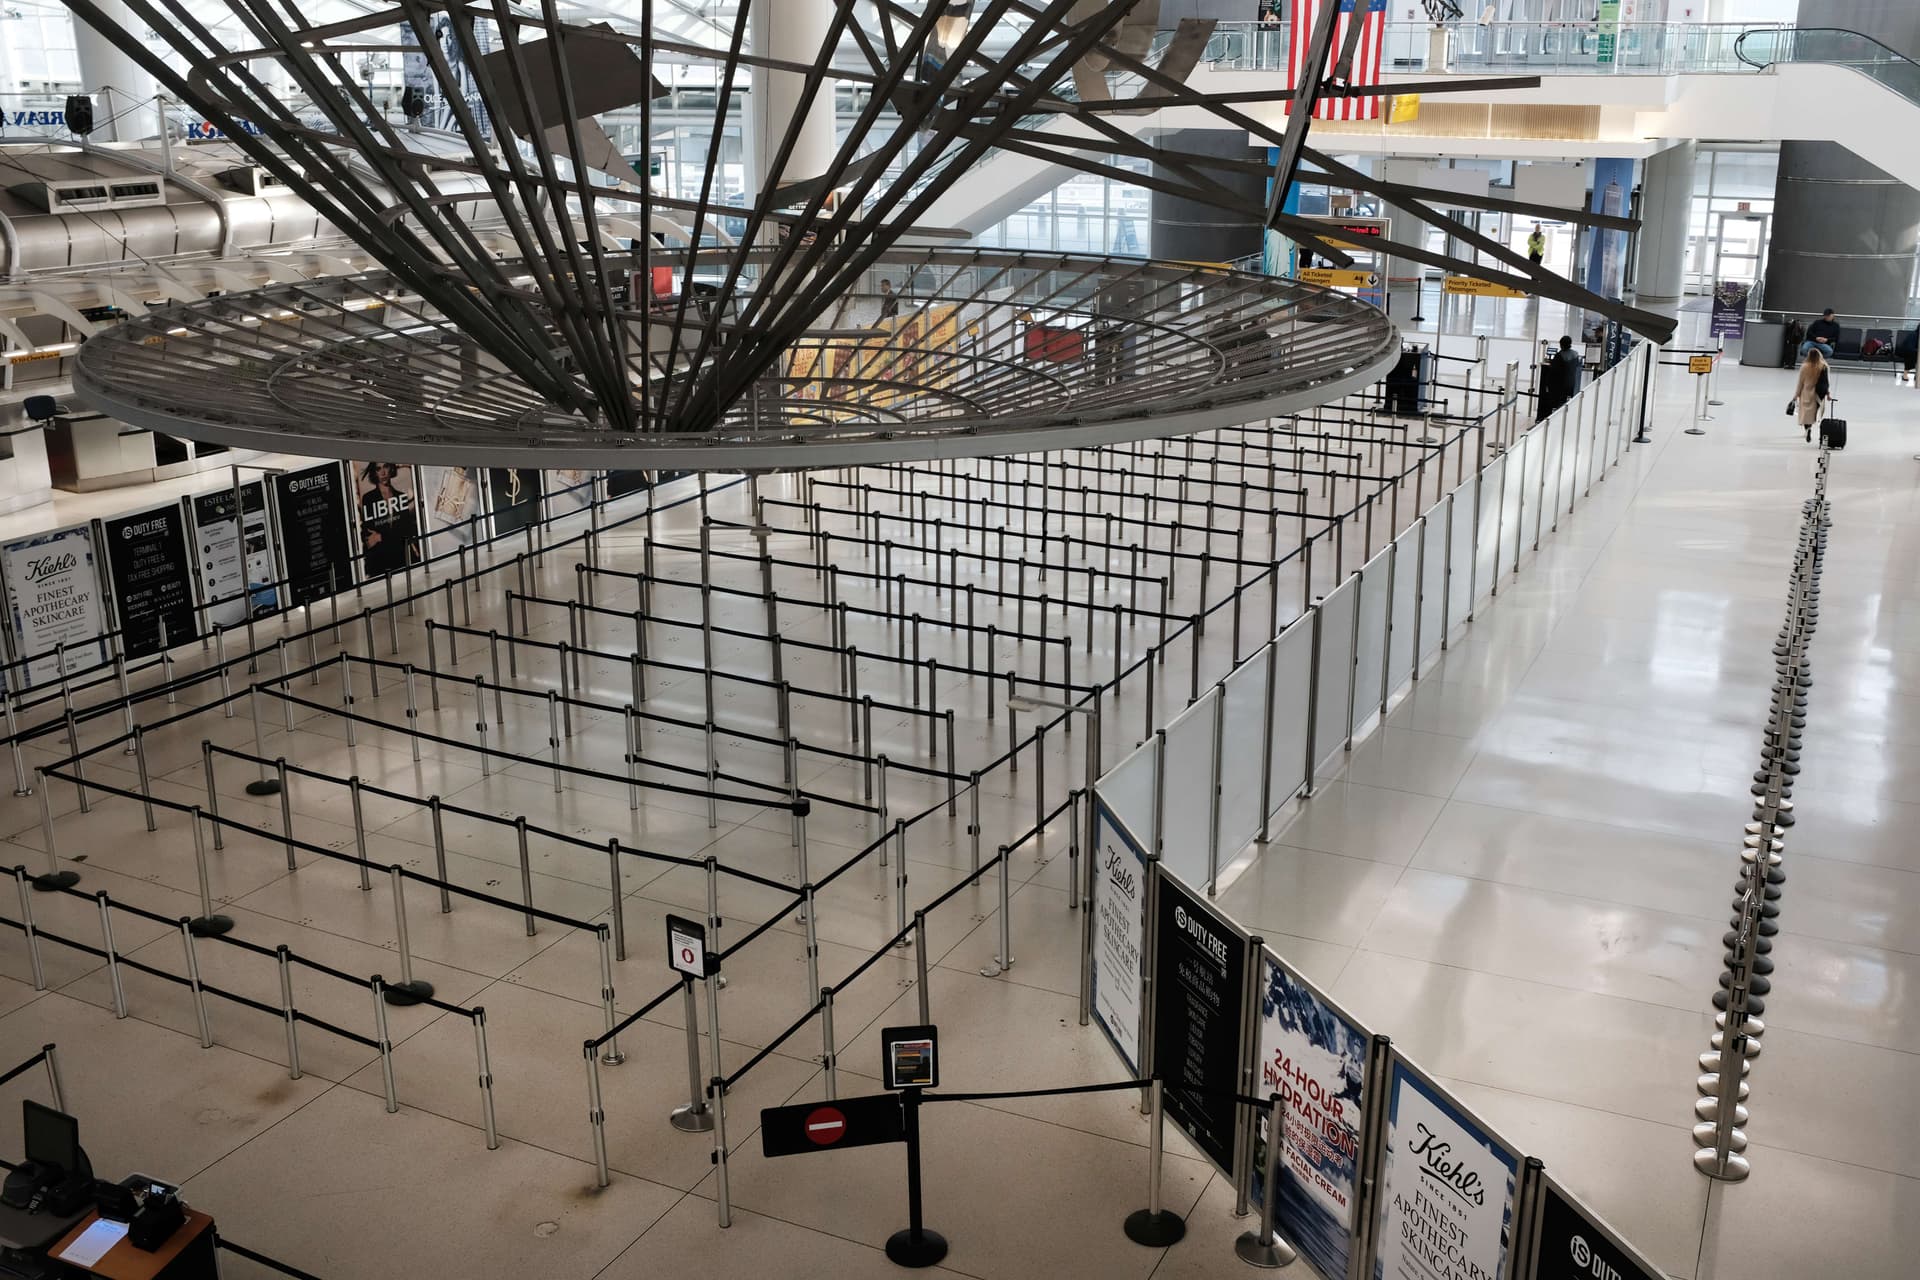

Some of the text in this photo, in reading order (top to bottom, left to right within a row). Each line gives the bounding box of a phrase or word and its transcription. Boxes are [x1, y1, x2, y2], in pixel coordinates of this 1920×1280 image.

[299, 477, 313, 489] DUTY
[314, 473, 328, 485] FREE
[133, 520, 149, 536] DUTY
[151, 517, 167, 530] FREE
[363, 493, 409, 521] LIBRE
[25, 553, 77, 581] Kiehl's
[23, 591, 90, 619] APOTHECARY
[32, 605, 86, 628] SKINCARE
[37, 585, 74, 603] FINEST
[1105, 845, 1135, 899] Kiehl's
[1101, 903, 1139, 964] APOTHECARY
[1109, 897, 1130, 934] FINEST
[1104, 924, 1134, 975] SKINCARE
[1188, 916, 1208, 945] DUTY
[1208, 932, 1228, 963] FREE
[1274, 1048, 1344, 1123] 24-HOUR
[1264, 1061, 1355, 1160] HYDRATION
[1286, 1146, 1314, 1178] FACIAL
[1315, 1174, 1346, 1207] CREAM
[1408, 1122, 1485, 1206] Kiehl's
[1415, 1189, 1469, 1248] FINEST
[1420, 1175, 1467, 1221] SINCE 1851
